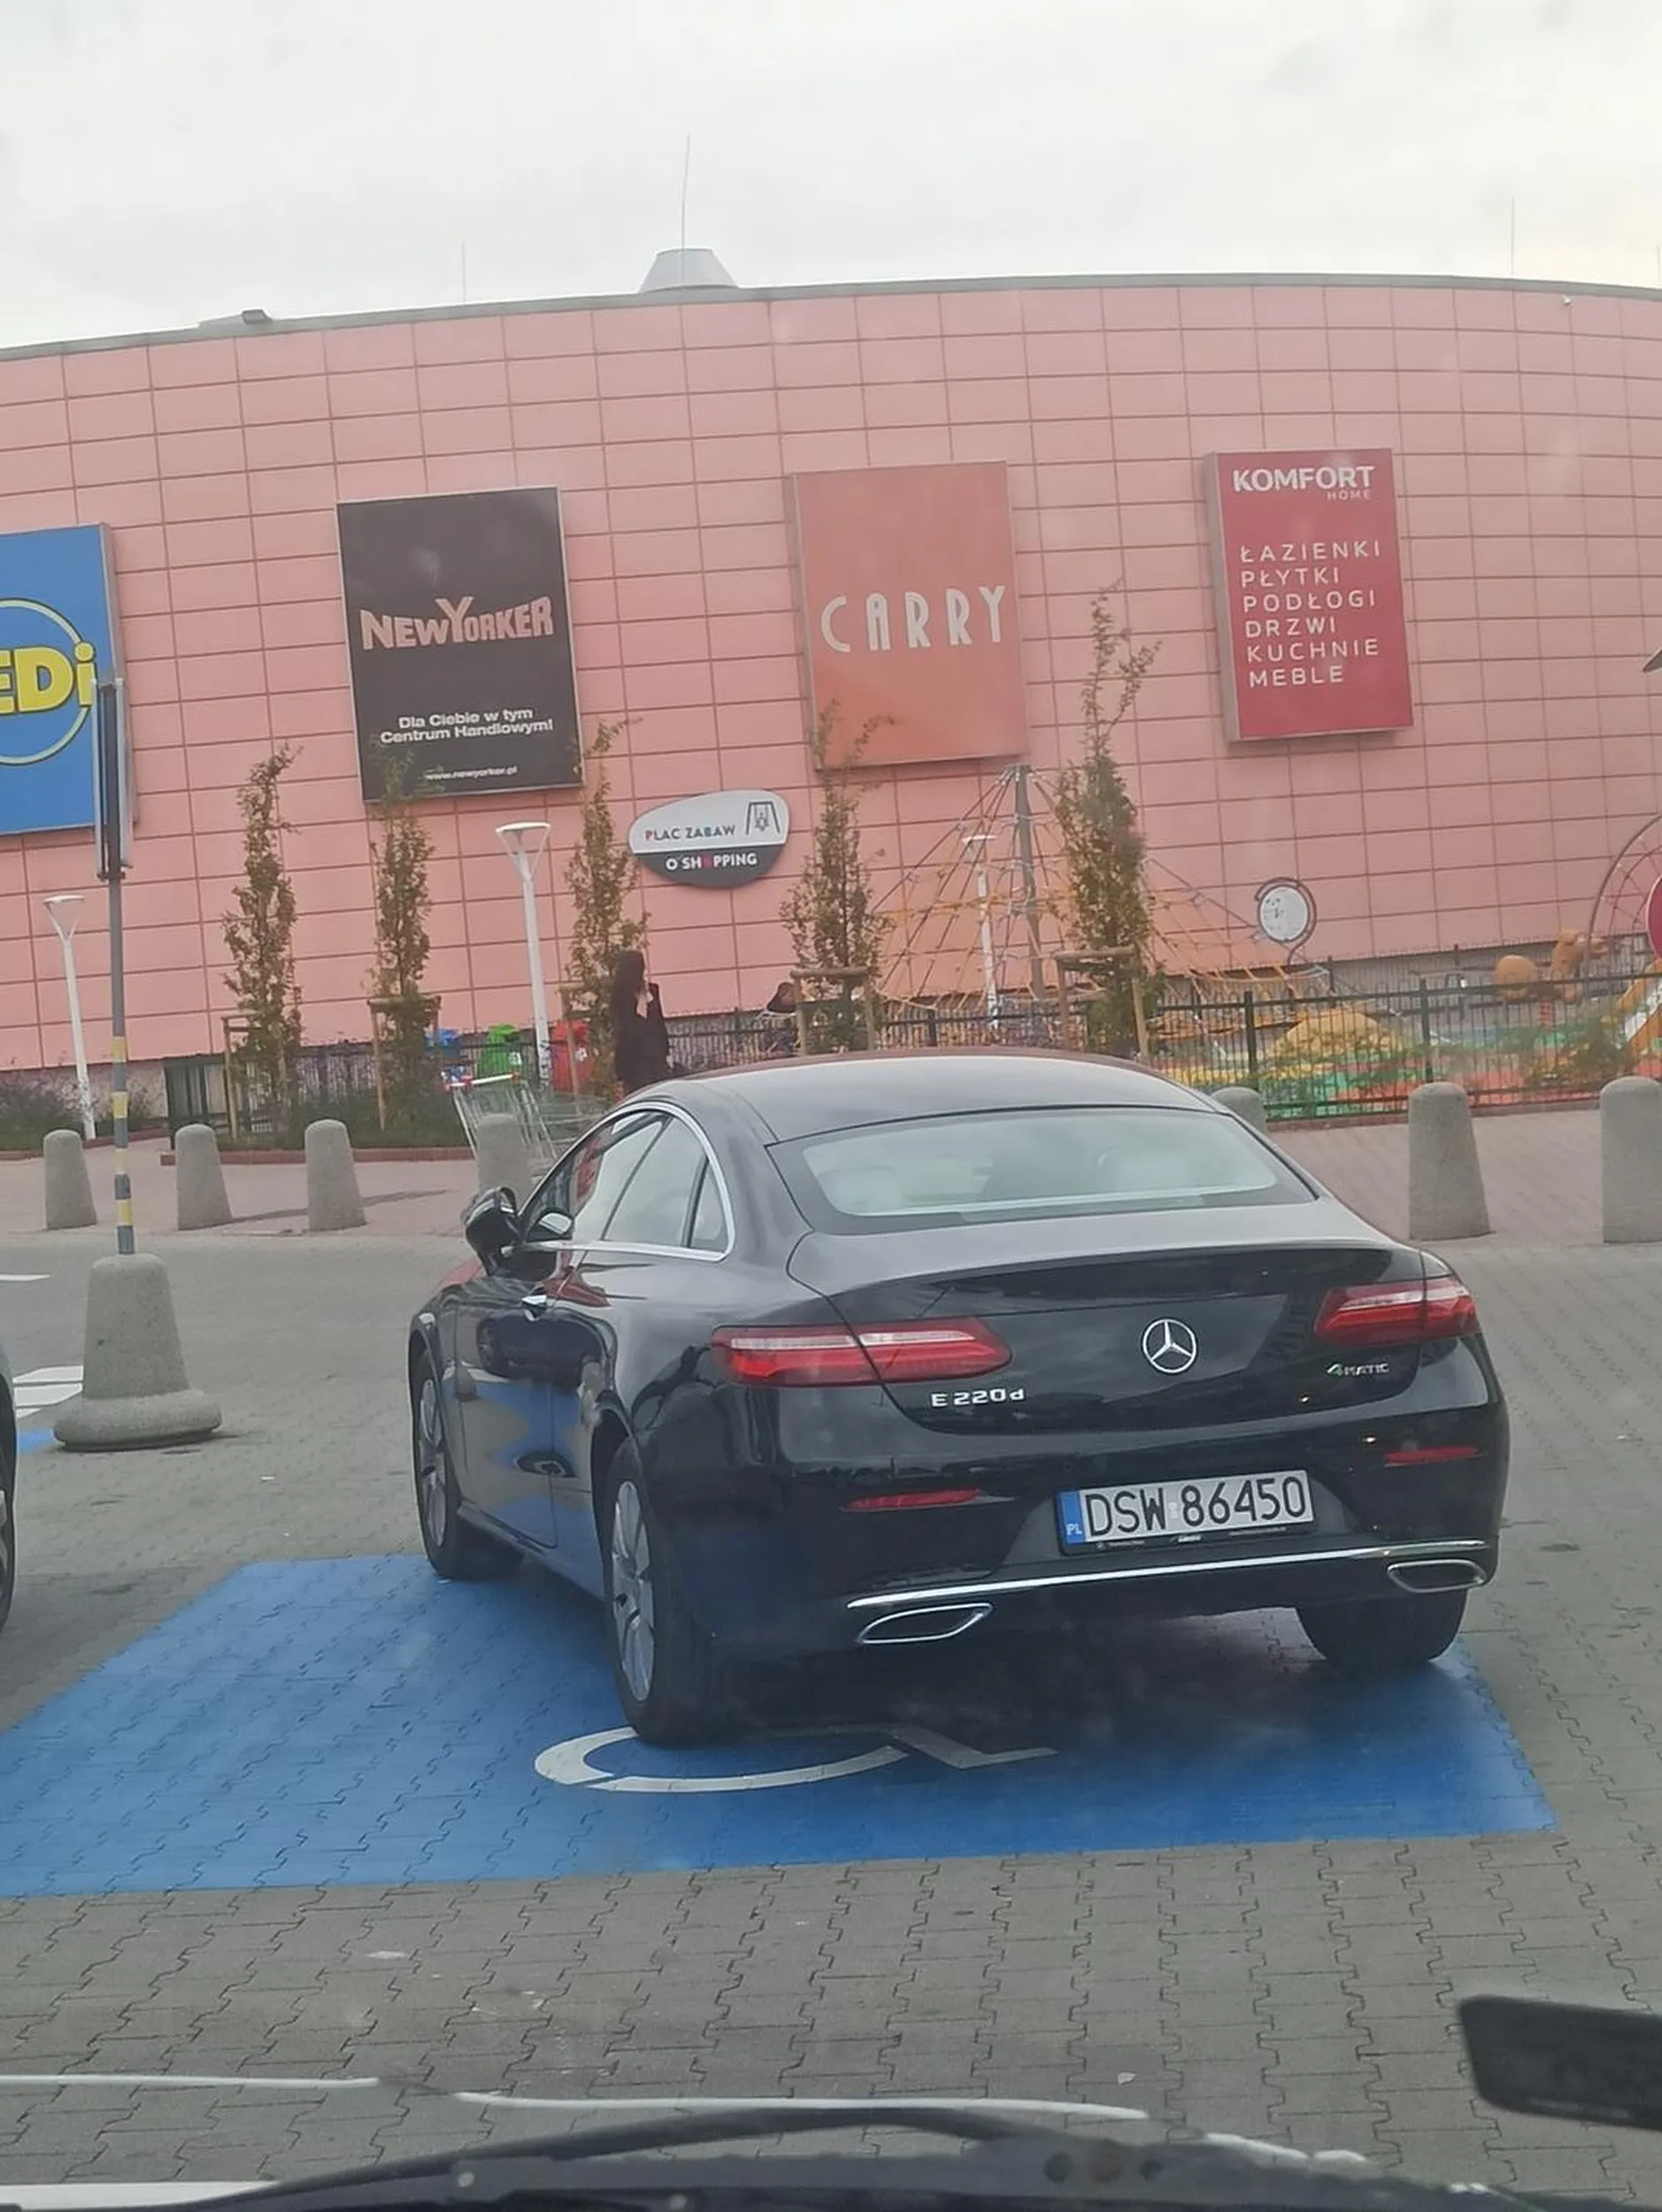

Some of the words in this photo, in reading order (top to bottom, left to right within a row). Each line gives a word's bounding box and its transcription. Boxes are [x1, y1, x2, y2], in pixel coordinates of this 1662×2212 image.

[1233, 465, 1375, 492] KOMFORT
[1327, 488, 1372, 501] HOME
[1240, 540, 1381, 564] ŁAZIENKI
[1241, 566, 1340, 588] PŁYTKI
[1243, 589, 1375, 613] PODŁOGI
[820, 585, 1006, 653] CARRY
[1245, 616, 1336, 638] DRZWI
[1246, 638, 1379, 664] KUCHNIE
[1249, 665, 1344, 688] MEBLE
[398, 716, 426, 729] Dla
[429, 710, 481, 726] Ciebie
[484, 710, 499, 722] w
[503, 707, 534, 722] tym
[381, 728, 451, 744] Centrum
[645, 827, 681, 841] PLAC
[685, 825, 736, 839] ZABAW
[953, 1387, 1025, 1406] 220d
[1066, 1523, 1083, 1536] PL
[1085, 1486, 1166, 1537] DSW
[1180, 1475, 1306, 1528] 86450
